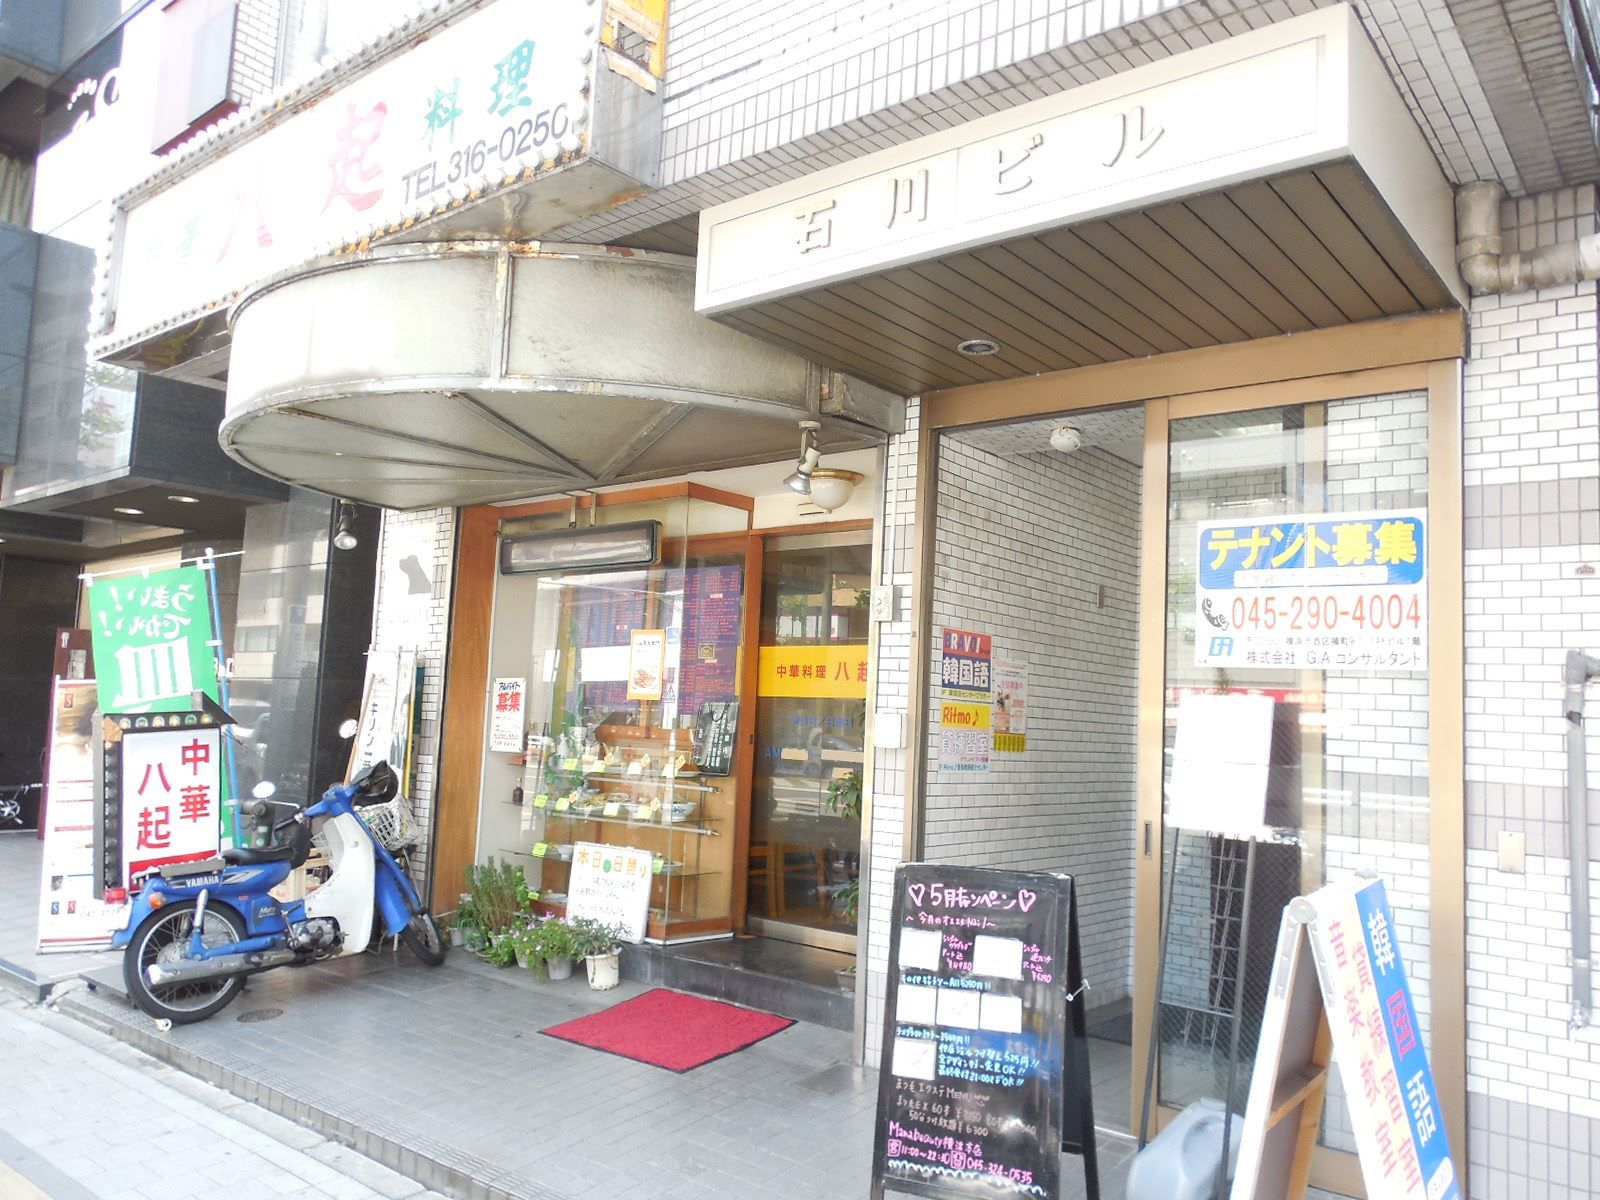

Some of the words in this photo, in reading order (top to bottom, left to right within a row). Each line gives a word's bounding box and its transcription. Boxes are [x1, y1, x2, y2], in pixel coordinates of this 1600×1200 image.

[796, 105, 1165, 255] 石川ビル
[1207, 519, 1419, 571] テナント募集
[1231, 594, 1421, 630] 045-290-4004
[776, 664, 826, 679] 中華料理
[942, 656, 990, 688] 韓国語
[495, 690, 522, 712] 募集
[180, 738, 210, 823] 中華
[136, 762, 172, 851] 八起
[186, 874, 220, 888] YAMAHA
